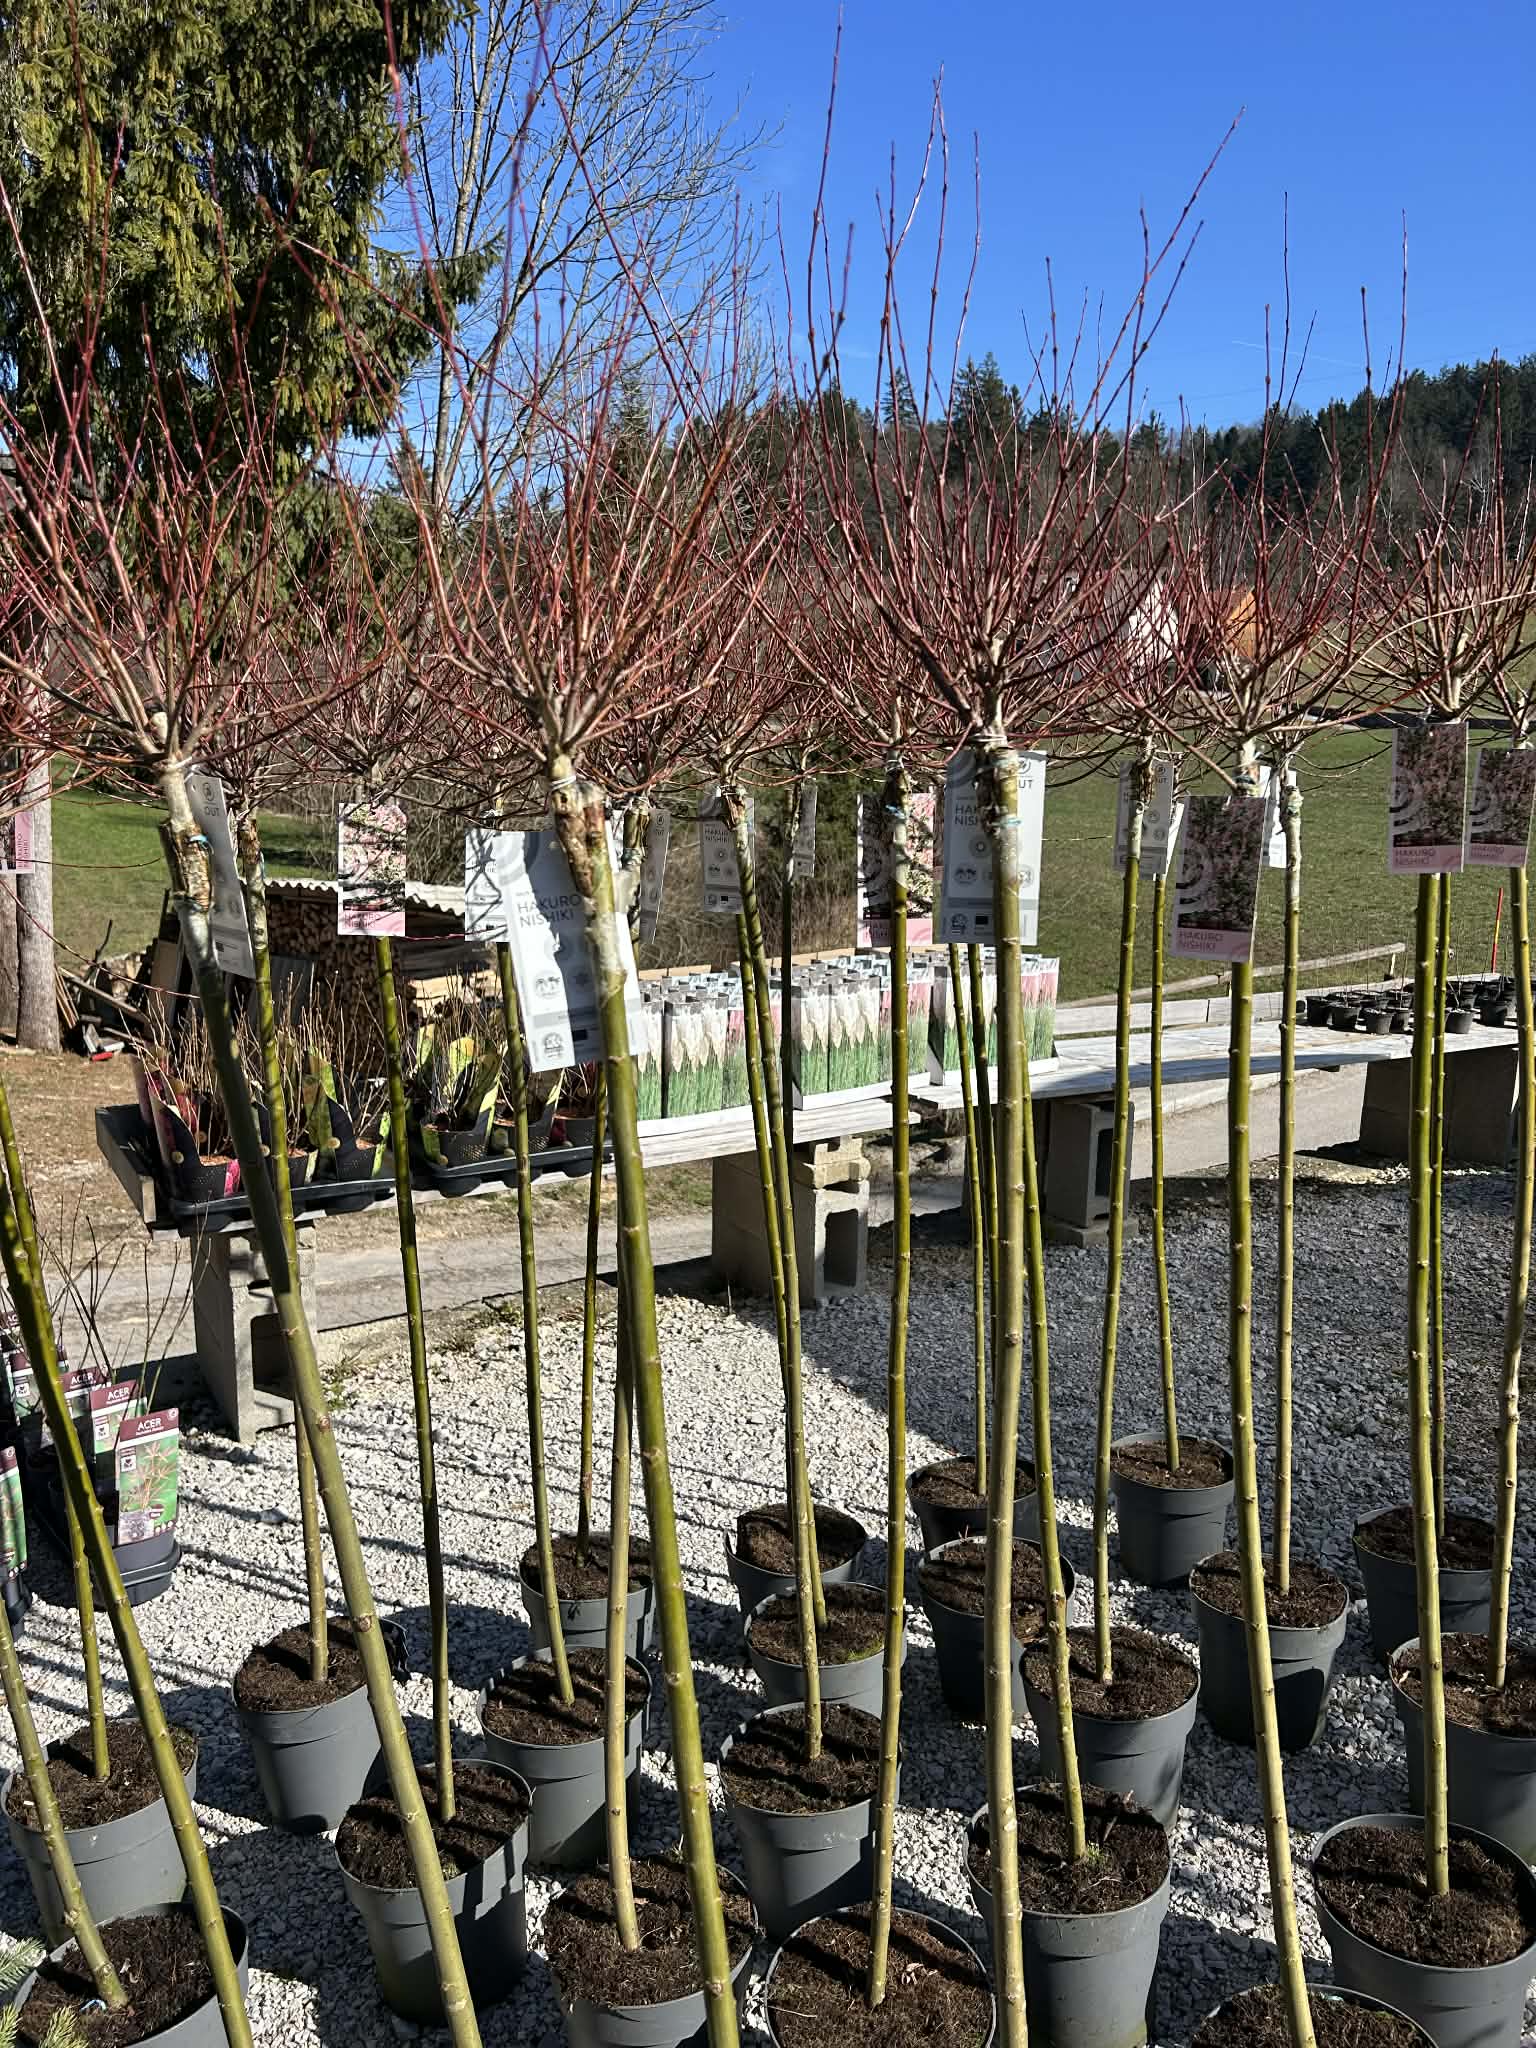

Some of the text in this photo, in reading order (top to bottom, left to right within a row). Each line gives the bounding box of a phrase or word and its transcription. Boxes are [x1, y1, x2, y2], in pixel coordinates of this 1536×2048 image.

[517, 893, 583, 913] HAKURO
[519, 909, 575, 929] NISHIKI
[107, 1387, 131, 1401] ACER
[137, 1417, 162, 1432] ACER
